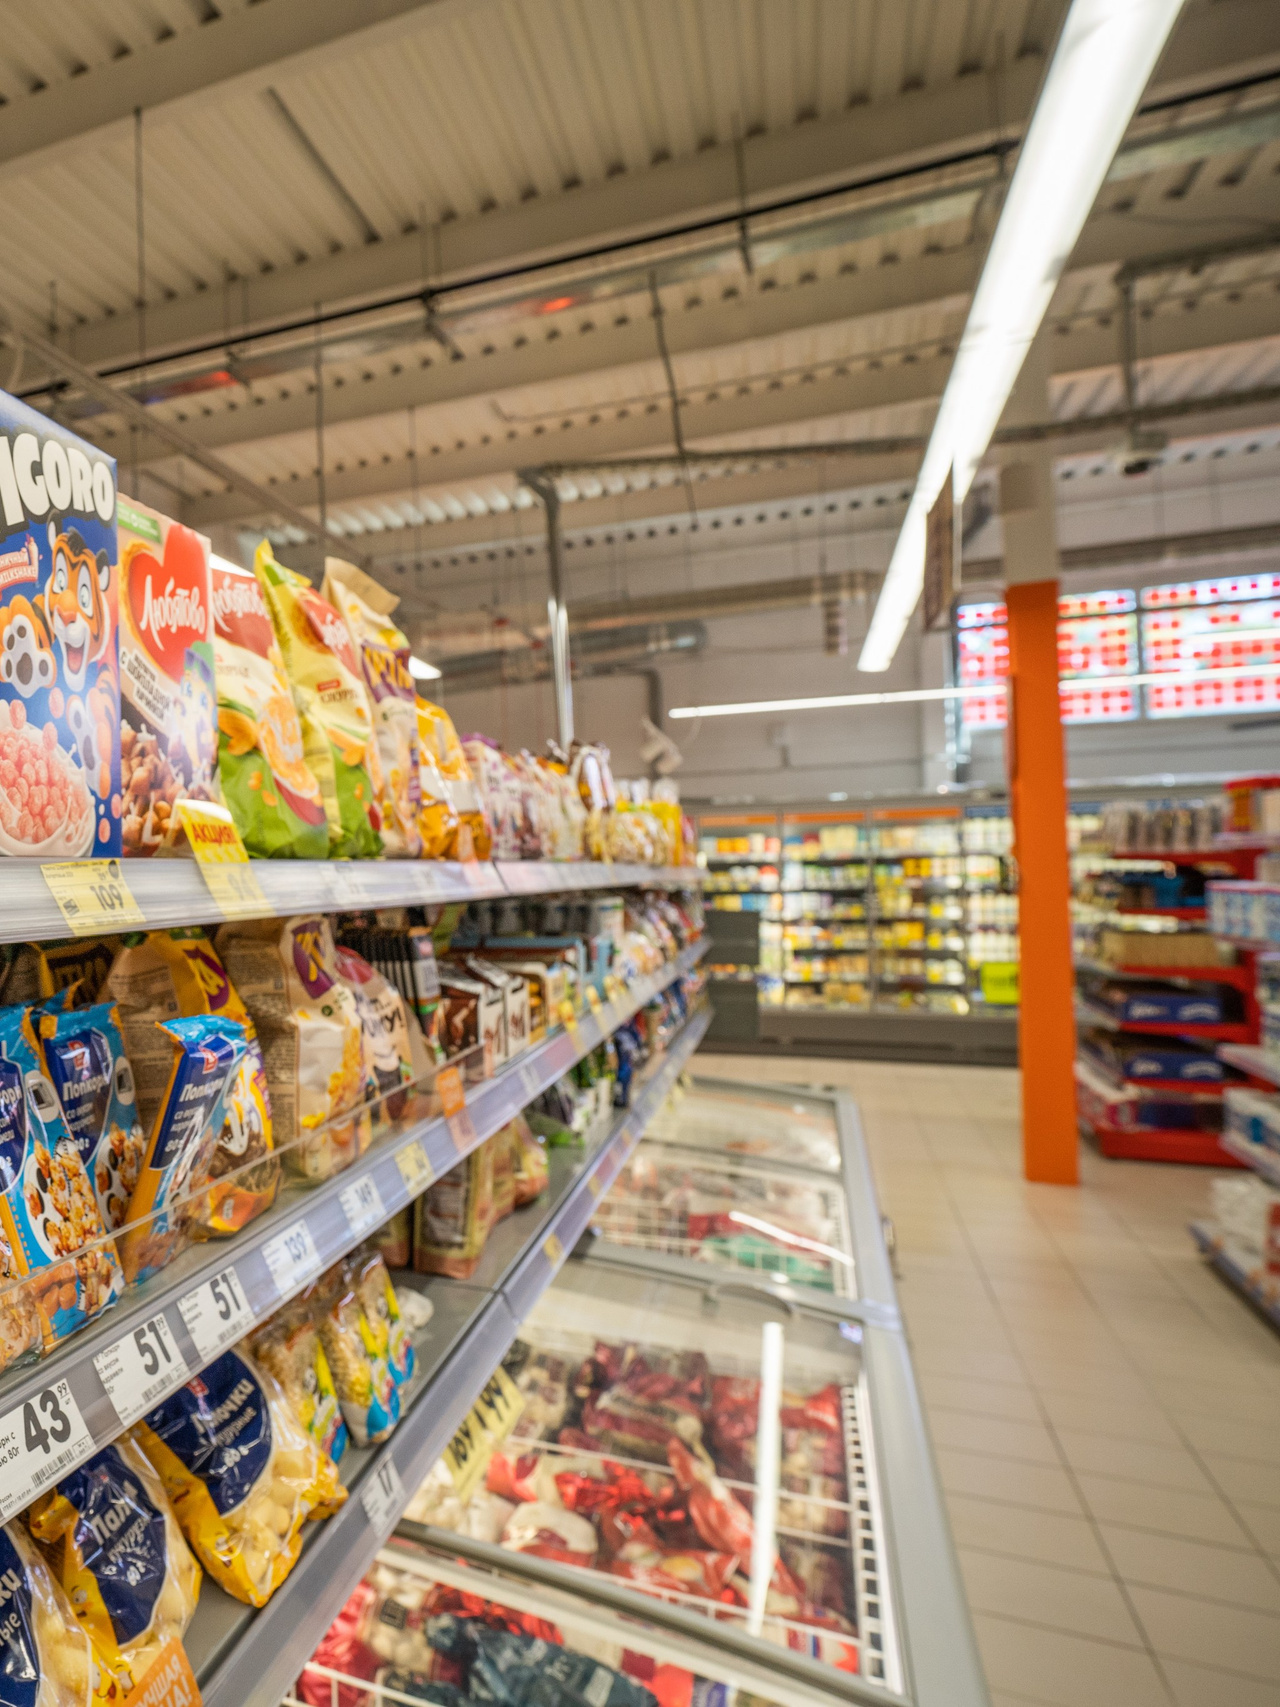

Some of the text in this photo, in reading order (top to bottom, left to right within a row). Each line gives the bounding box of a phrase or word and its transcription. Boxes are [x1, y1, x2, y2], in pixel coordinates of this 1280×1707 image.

[139, 574, 205, 651] Любятово
[89, 883, 124, 912] 109
[284, 1231, 307, 1263] 139
[209, 1272, 241, 1321] 51
[133, 1320, 171, 1376] 51
[10, 1431, 16, 1440] с
[23, 1382, 71, 1455] 43 99
[7, 1446, 20, 1460] 80г
